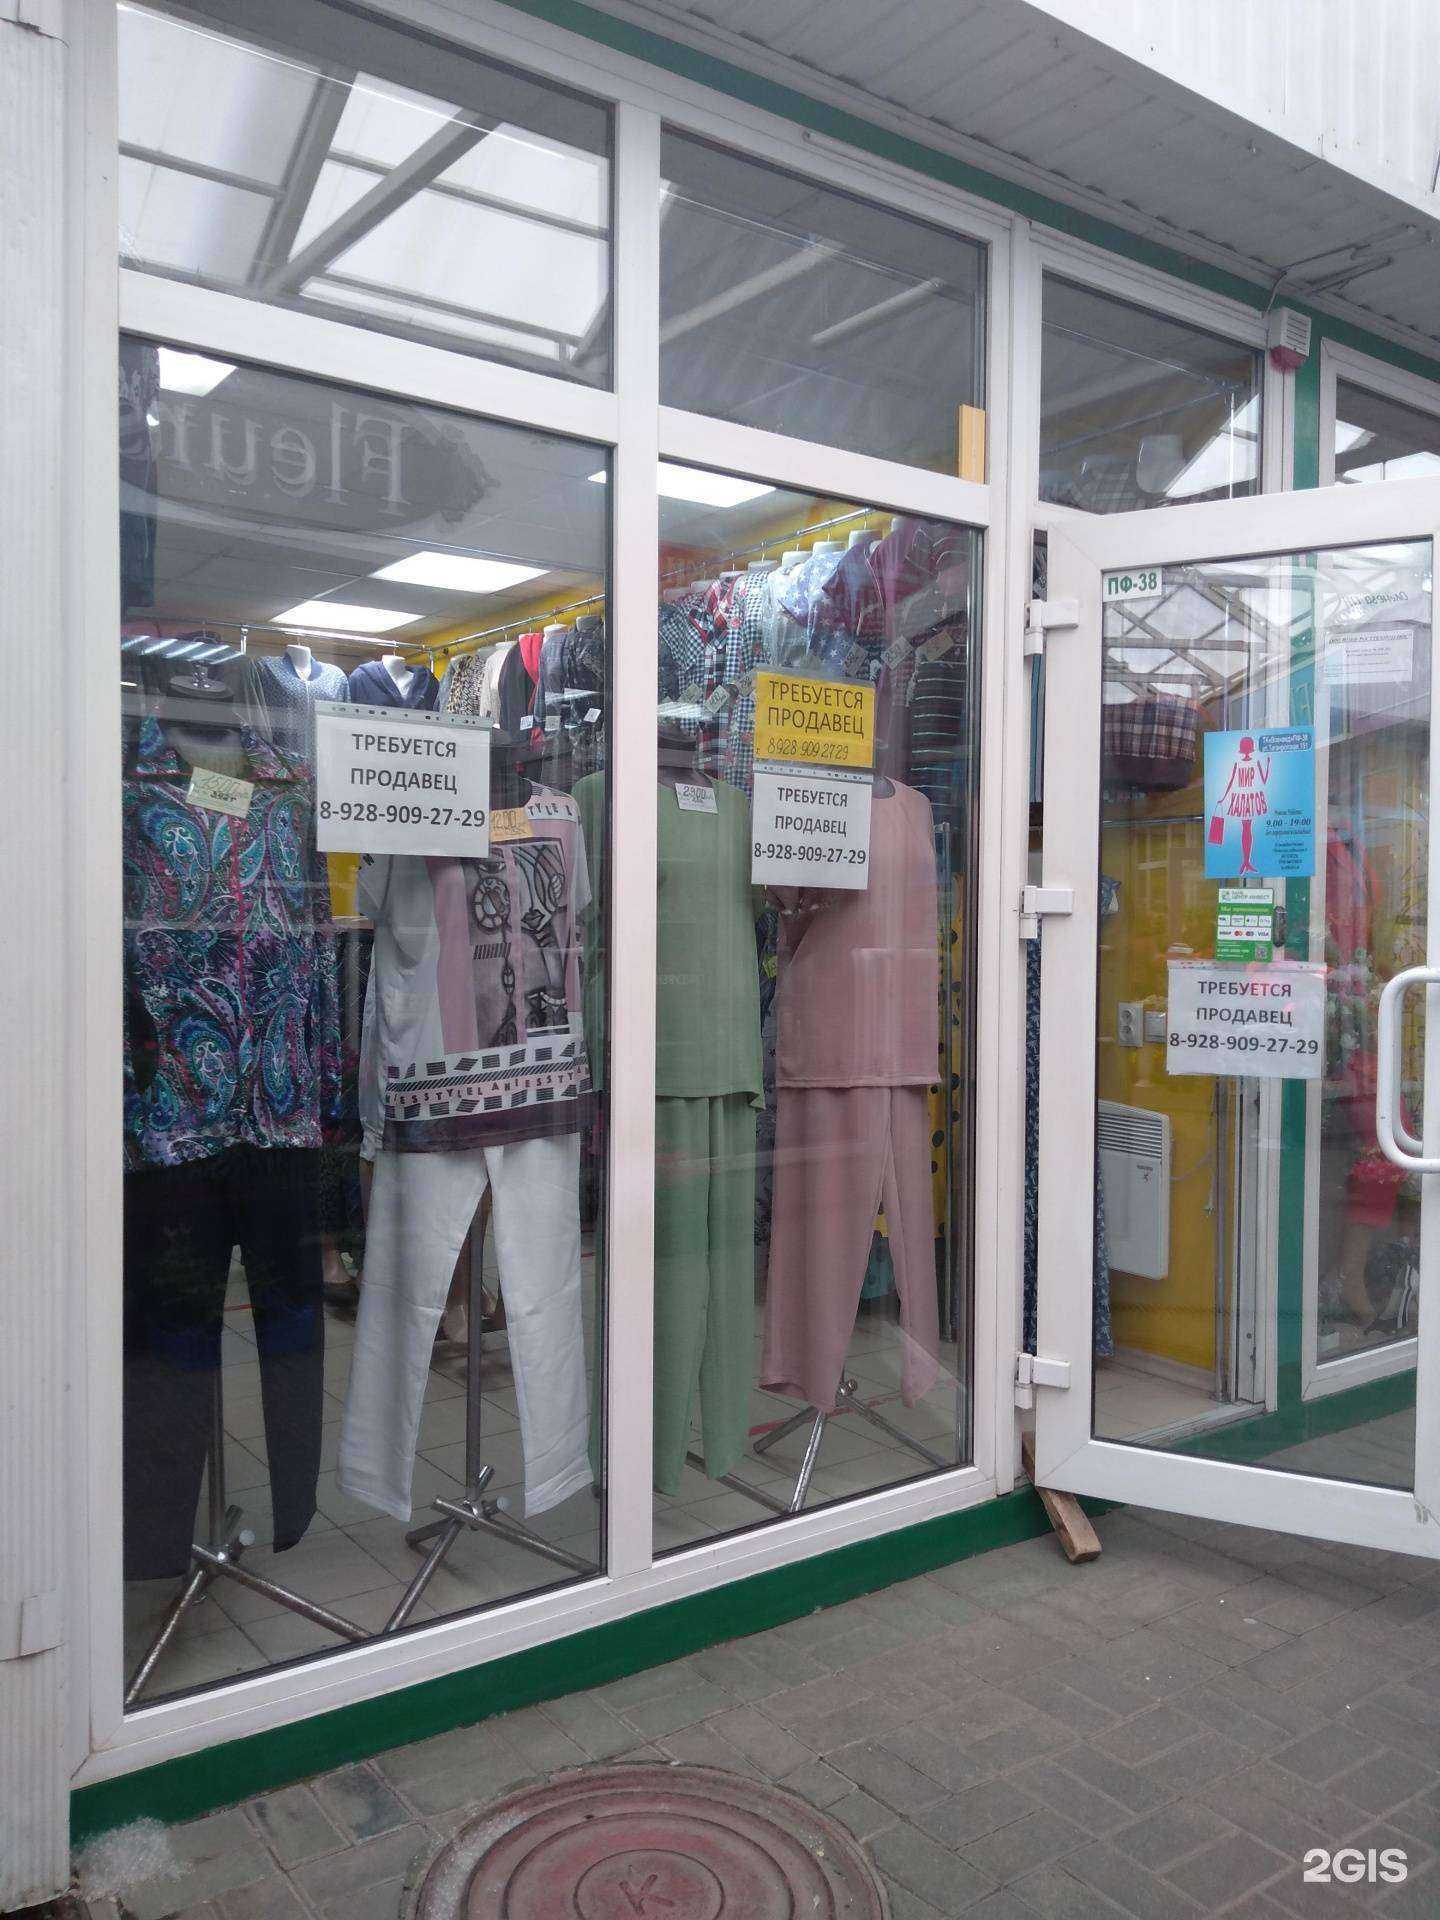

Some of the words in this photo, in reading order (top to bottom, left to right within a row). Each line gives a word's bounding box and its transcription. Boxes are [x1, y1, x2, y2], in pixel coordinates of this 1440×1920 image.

[1108, 573, 1157, 595] ПФ-38
[769, 681, 863, 710] ТРЕБУЕТСЯ
[768, 707, 864, 739] ПРОДАВЕЦ
[352, 733, 457, 758] ТРЕБУЕТСЯ
[351, 768, 458, 794] ПРОДАВЕЦ
[1238, 766, 1255, 788] МИР
[777, 787, 848, 807] ТРЕБУЕТСЯ
[1228, 791, 1268, 817] ХАЛАТОВ
[320, 800, 486, 827] 8-928-909-27-29
[775, 815, 847, 837] ПРОДАВЕЦ
[754, 843, 866, 865] 8-928-909-27-29
[1198, 981, 1291, 998] ТРЕБУЕТСЯ
[1196, 1008, 1293, 1027] ПРОДАВЕЦ
[1170, 1032, 1319, 1055] 8-928-909-27-29
